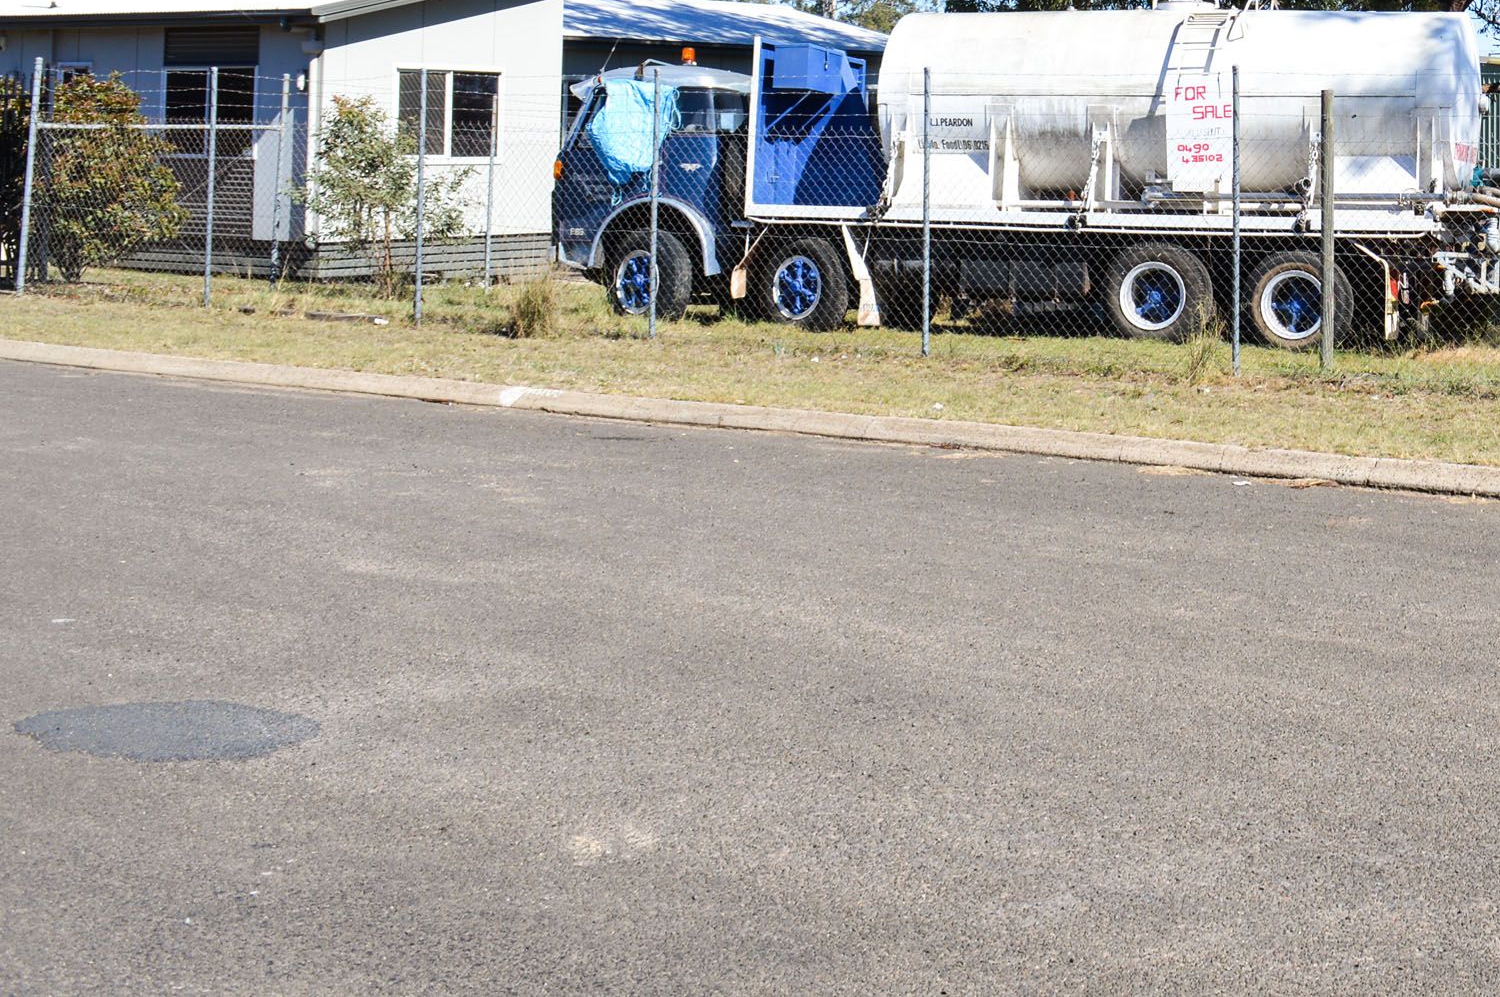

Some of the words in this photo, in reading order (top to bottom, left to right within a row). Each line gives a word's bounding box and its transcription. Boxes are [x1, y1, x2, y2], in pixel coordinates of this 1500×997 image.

[1175, 85, 1206, 101] FOR
[1192, 105, 1232, 120] SALE
[1177, 143, 1210, 154] 0490
